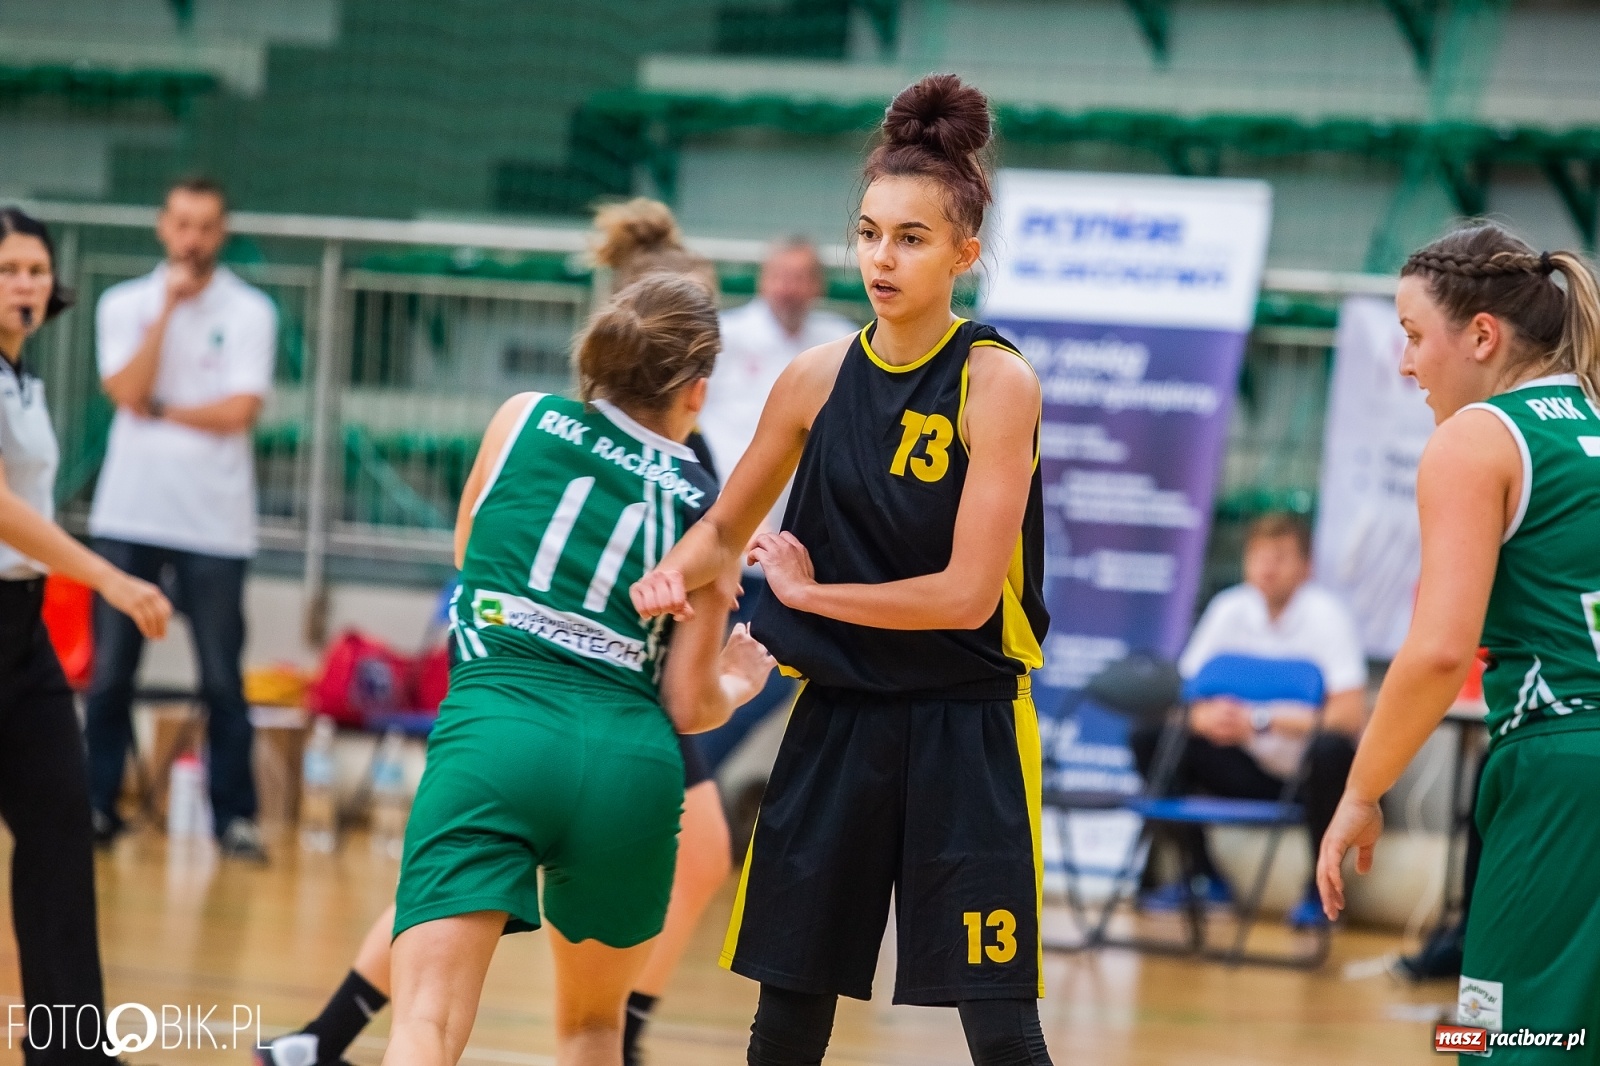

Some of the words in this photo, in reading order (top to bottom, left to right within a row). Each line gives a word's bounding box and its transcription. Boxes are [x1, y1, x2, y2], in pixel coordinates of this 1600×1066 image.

[536, 410, 592, 445] RKK
[1525, 396, 1588, 421] RKK
[889, 409, 954, 482] 13
[527, 476, 649, 613] 11
[963, 909, 1018, 964] 13
